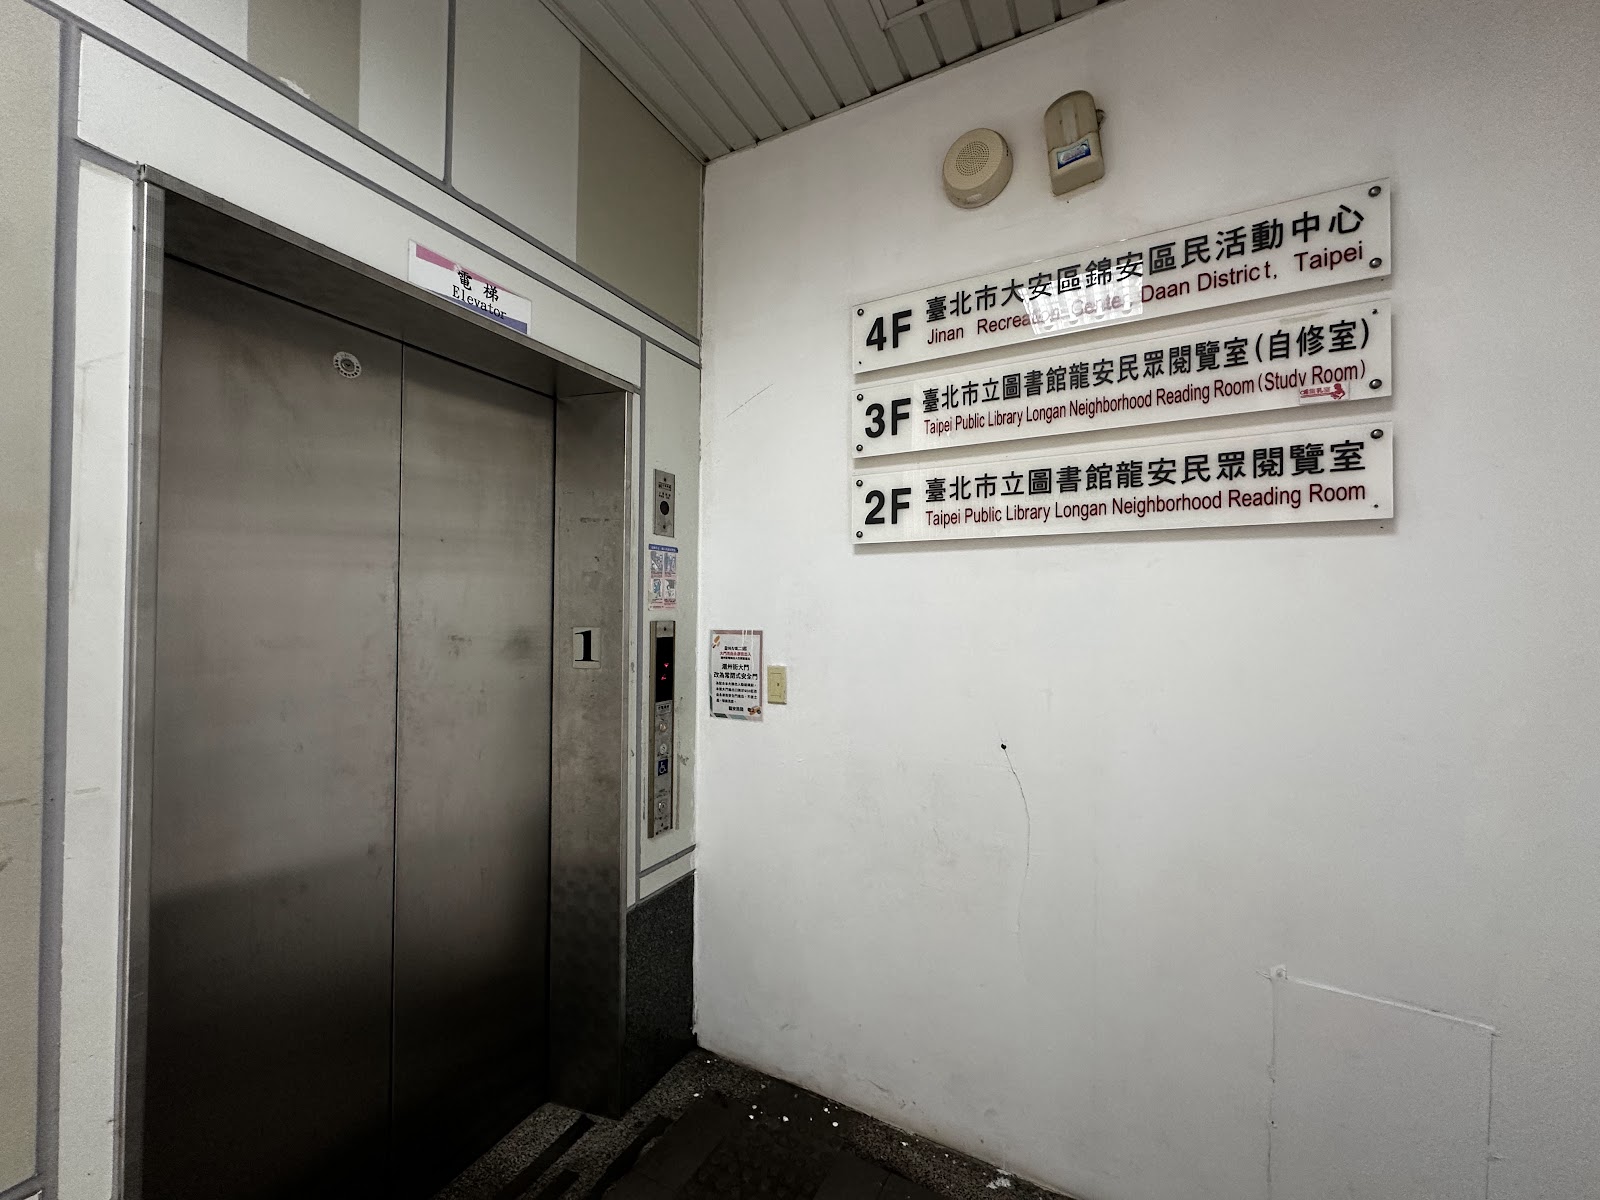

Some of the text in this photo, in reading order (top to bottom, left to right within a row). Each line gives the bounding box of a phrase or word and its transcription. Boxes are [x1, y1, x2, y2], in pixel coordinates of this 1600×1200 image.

[926, 204, 1364, 322] 臺北市大安區錦安區民活動中心
[452, 285, 507, 319] Elevator
[458, 270, 499, 302] 電梯
[927, 324, 964, 345] Jinan
[1142, 278, 1190, 303] Daan
[1197, 261, 1277, 292] District,
[1294, 241, 1363, 273] Taipei
[865, 309, 912, 351] 4F
[864, 398, 912, 438] 3F
[924, 417, 952, 435] Taipei
[955, 414, 985, 430] Public
[988, 409, 1023, 428] Library
[1026, 405, 1066, 425] Longan
[1069, 390, 1152, 417] Neighborhood
[1156, 383, 1210, 405] Reading
[1214, 377, 1254, 396] Room
[1312, 359, 1365, 385] Room)
[925, 439, 1365, 503] 臺北市立圖書館龍安民眾閱覽室
[864, 487, 912, 525] 2F
[926, 483, 1365, 528] Taipei Public Library Longan Neighborhood Reading Room
[575, 630, 599, 662] 1
